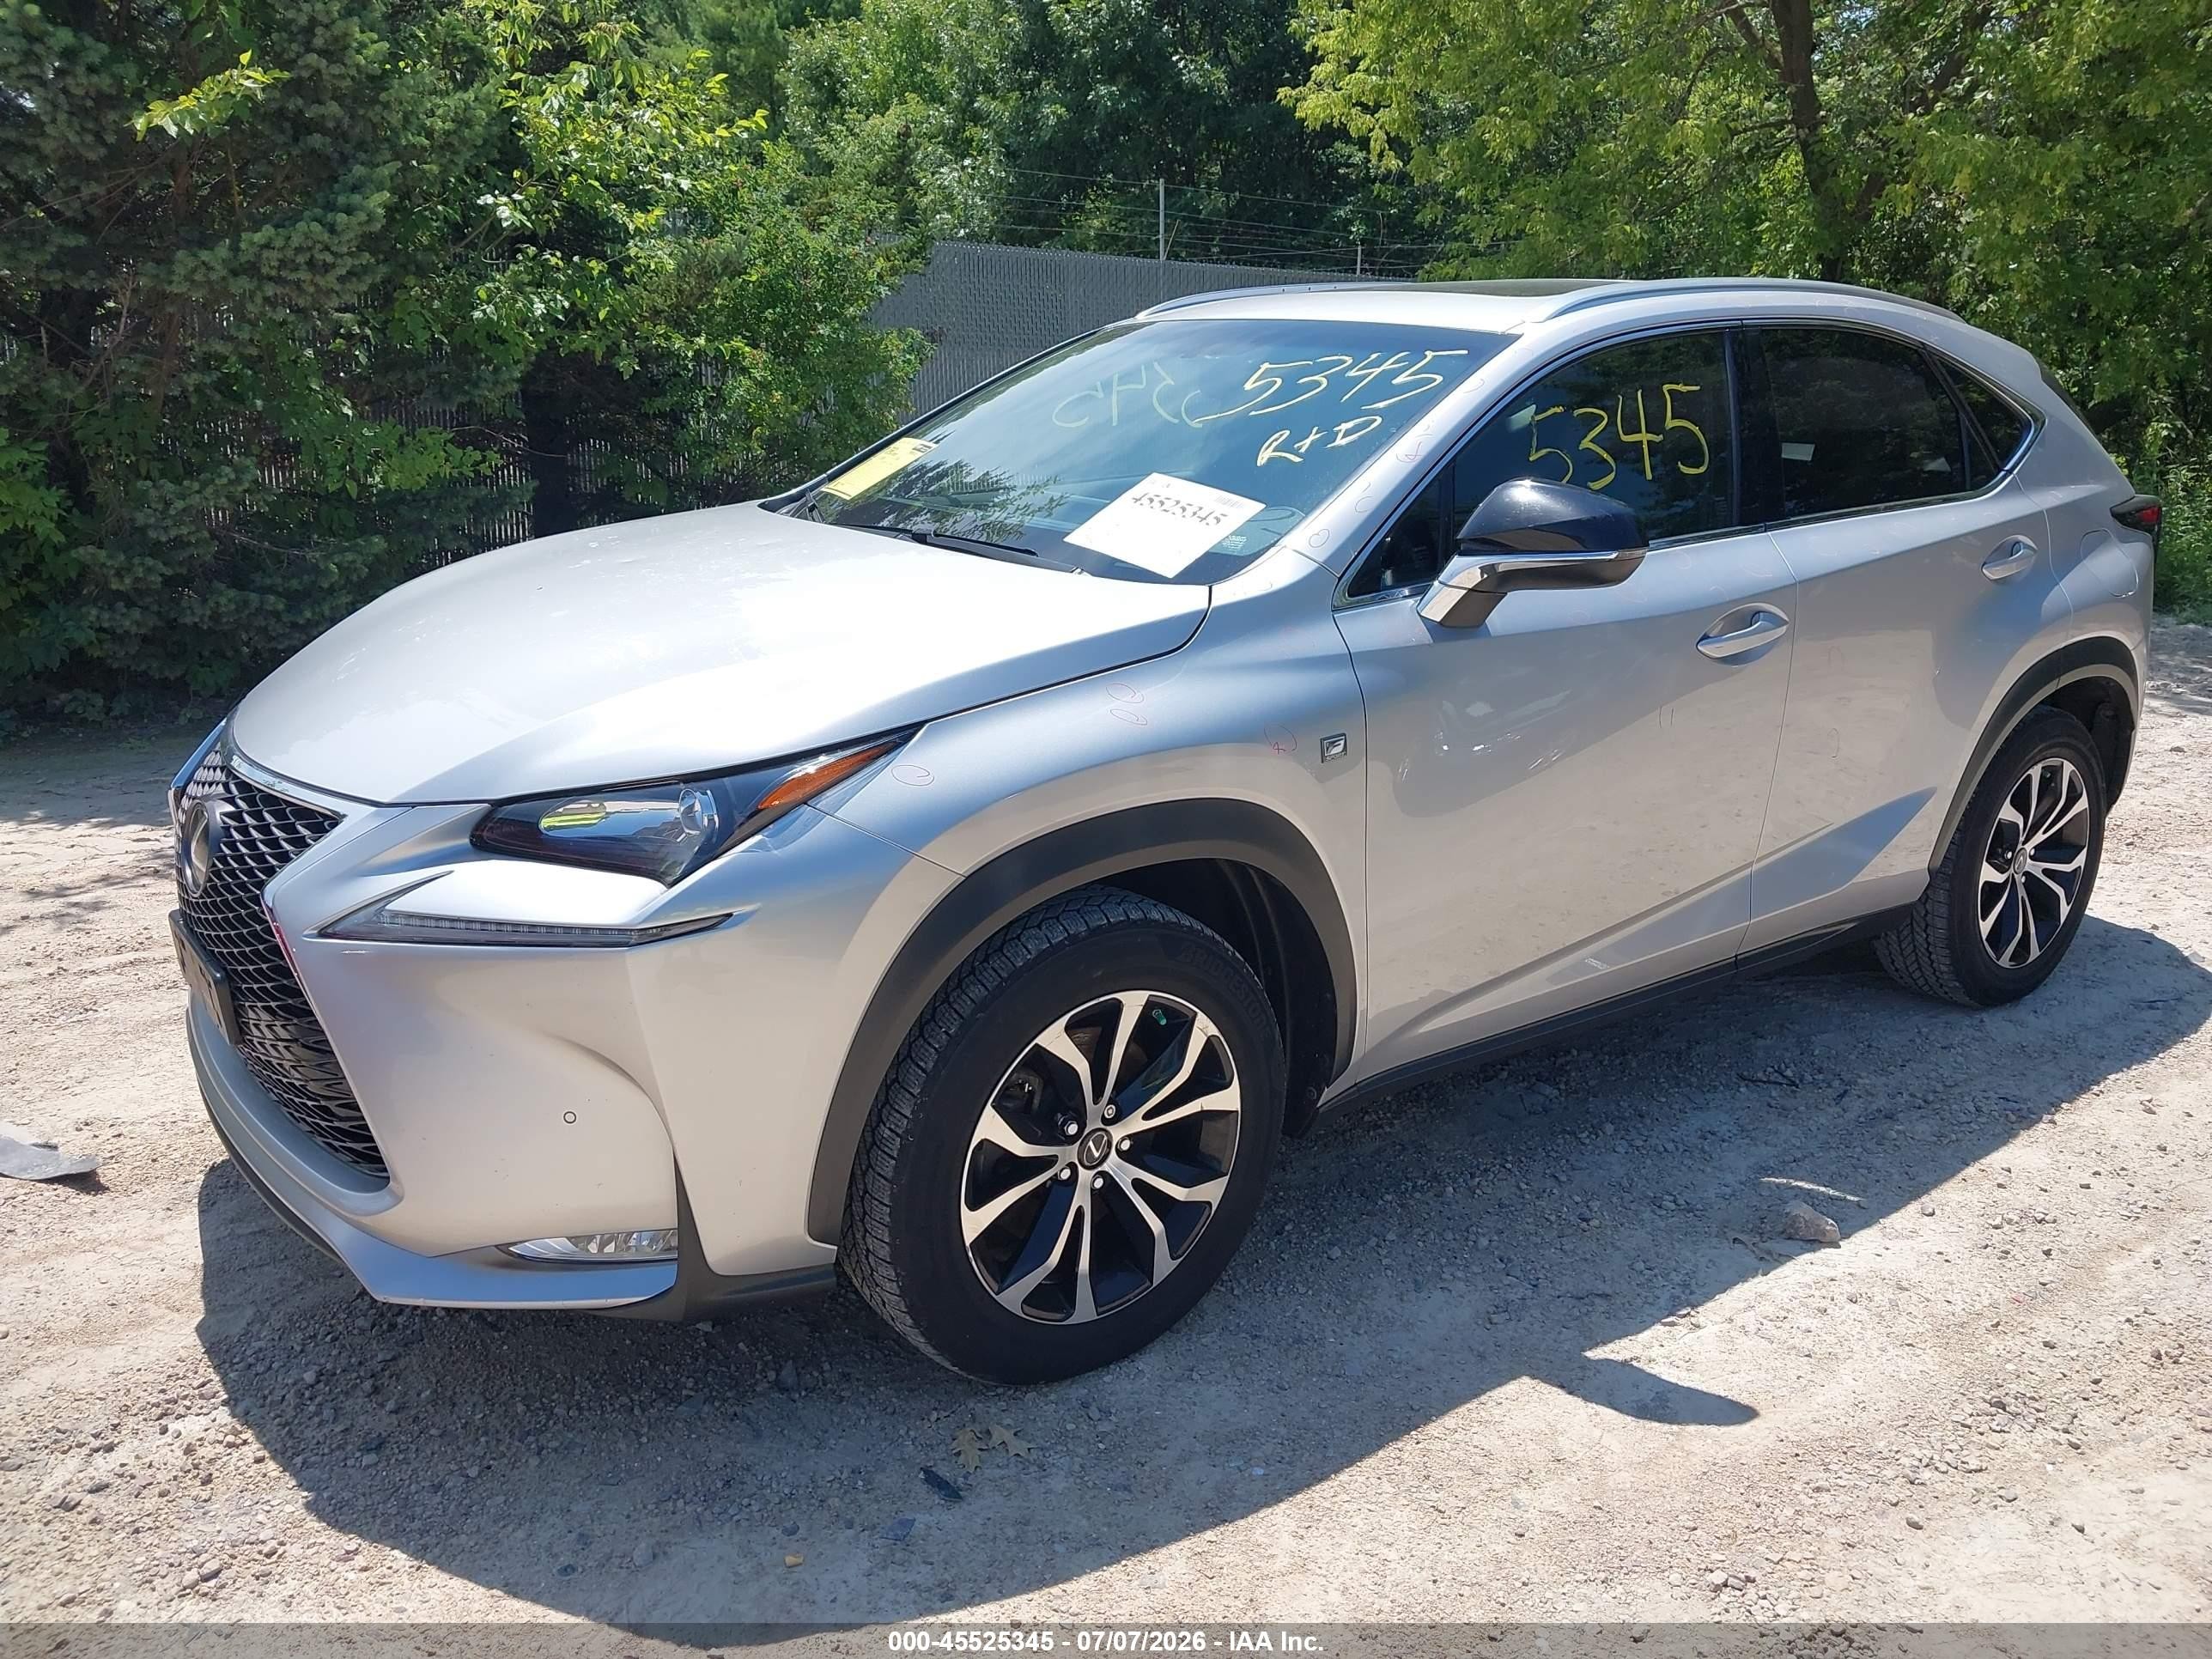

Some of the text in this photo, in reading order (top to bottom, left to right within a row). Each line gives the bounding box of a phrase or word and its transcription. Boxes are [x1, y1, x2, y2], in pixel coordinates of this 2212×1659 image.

[1194, 349, 1468, 424] 5345
[1528, 383, 1710, 490] 5345
[1131, 492, 1229, 526] 45525345
